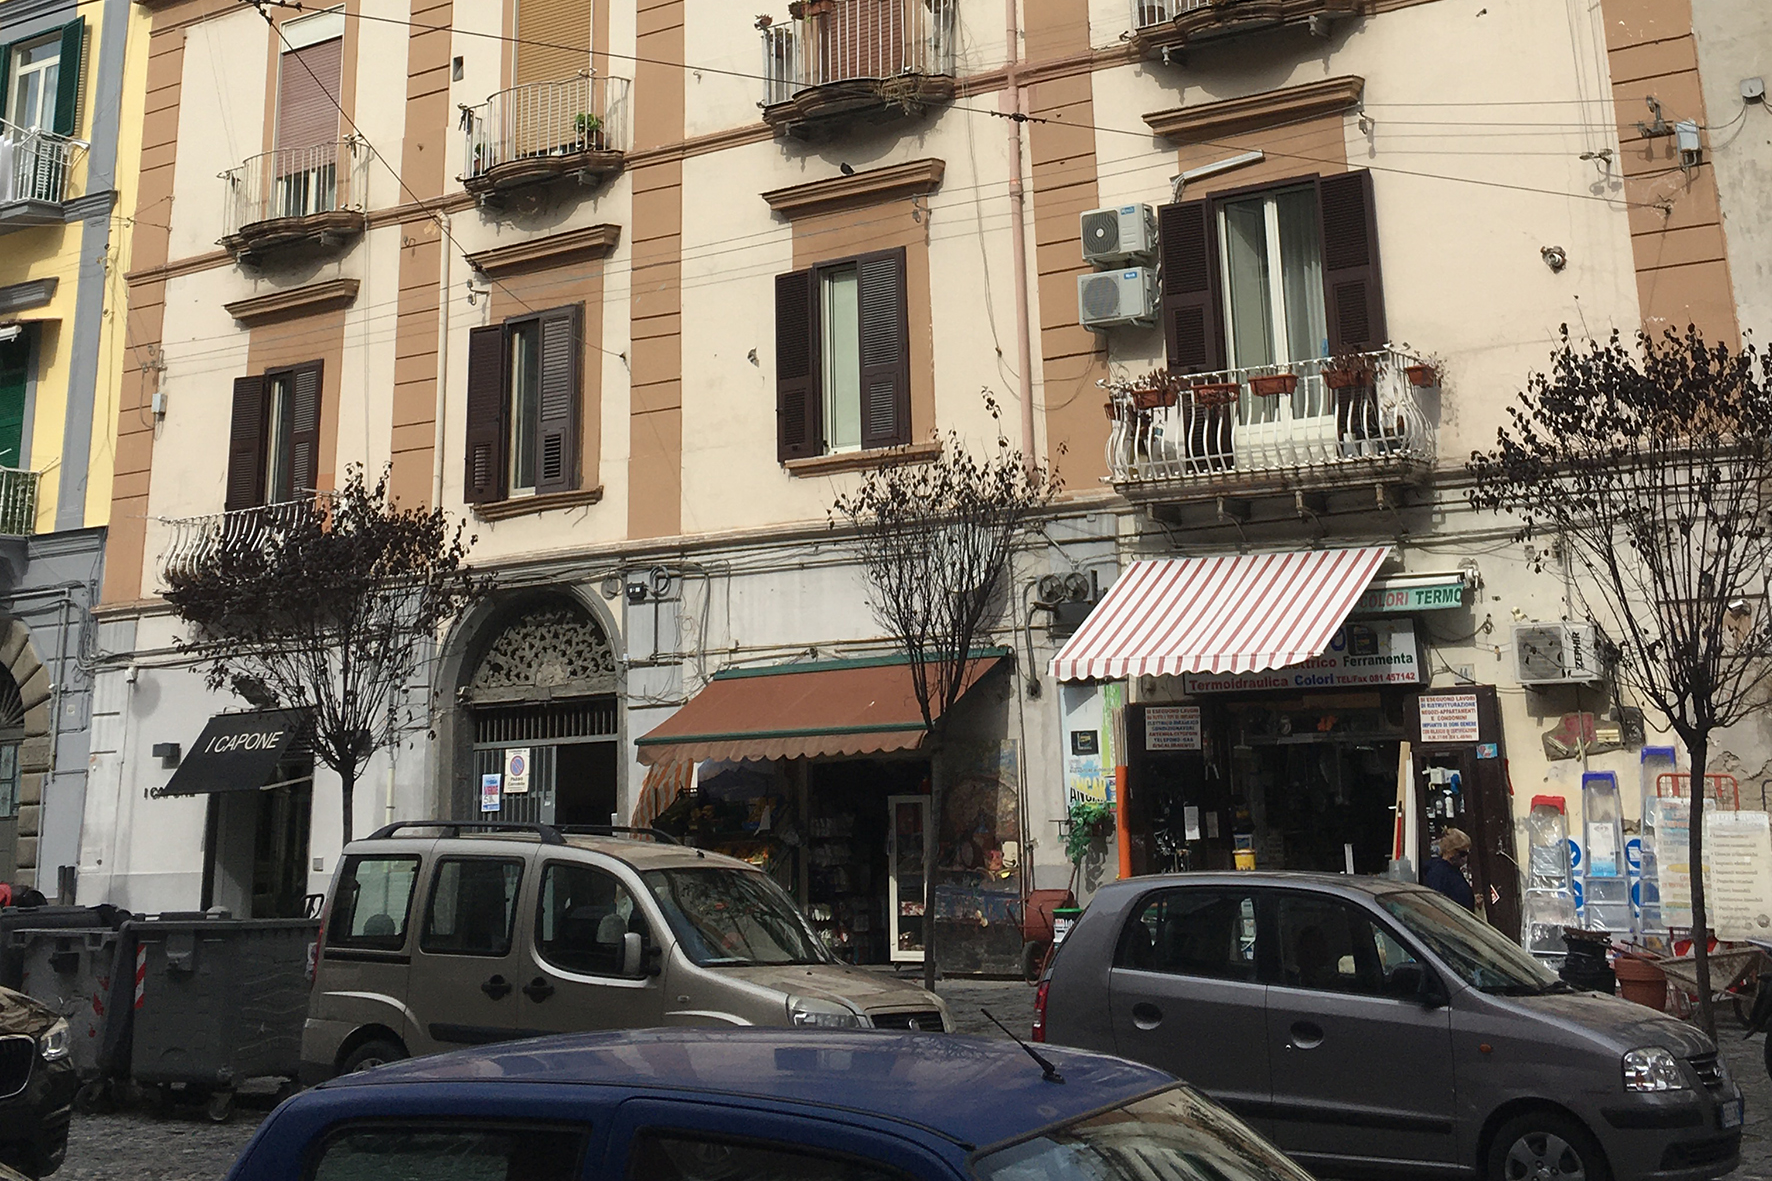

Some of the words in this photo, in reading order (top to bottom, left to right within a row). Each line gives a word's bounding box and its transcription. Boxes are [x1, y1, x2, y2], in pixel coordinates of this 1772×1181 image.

[1360, 592, 1409, 608] COLORI
[1343, 652, 1413, 667] Ferramenta
[1572, 631, 1583, 670] ZEPHIR
[1189, 675, 1289, 691] Termoidraulica
[1294, 674, 1334, 686] Colori
[1369, 674, 1384, 682] 081
[1386, 672, 1415, 681] 457142
[205, 736, 216, 754] I
[214, 731, 284, 753] CAPONE
